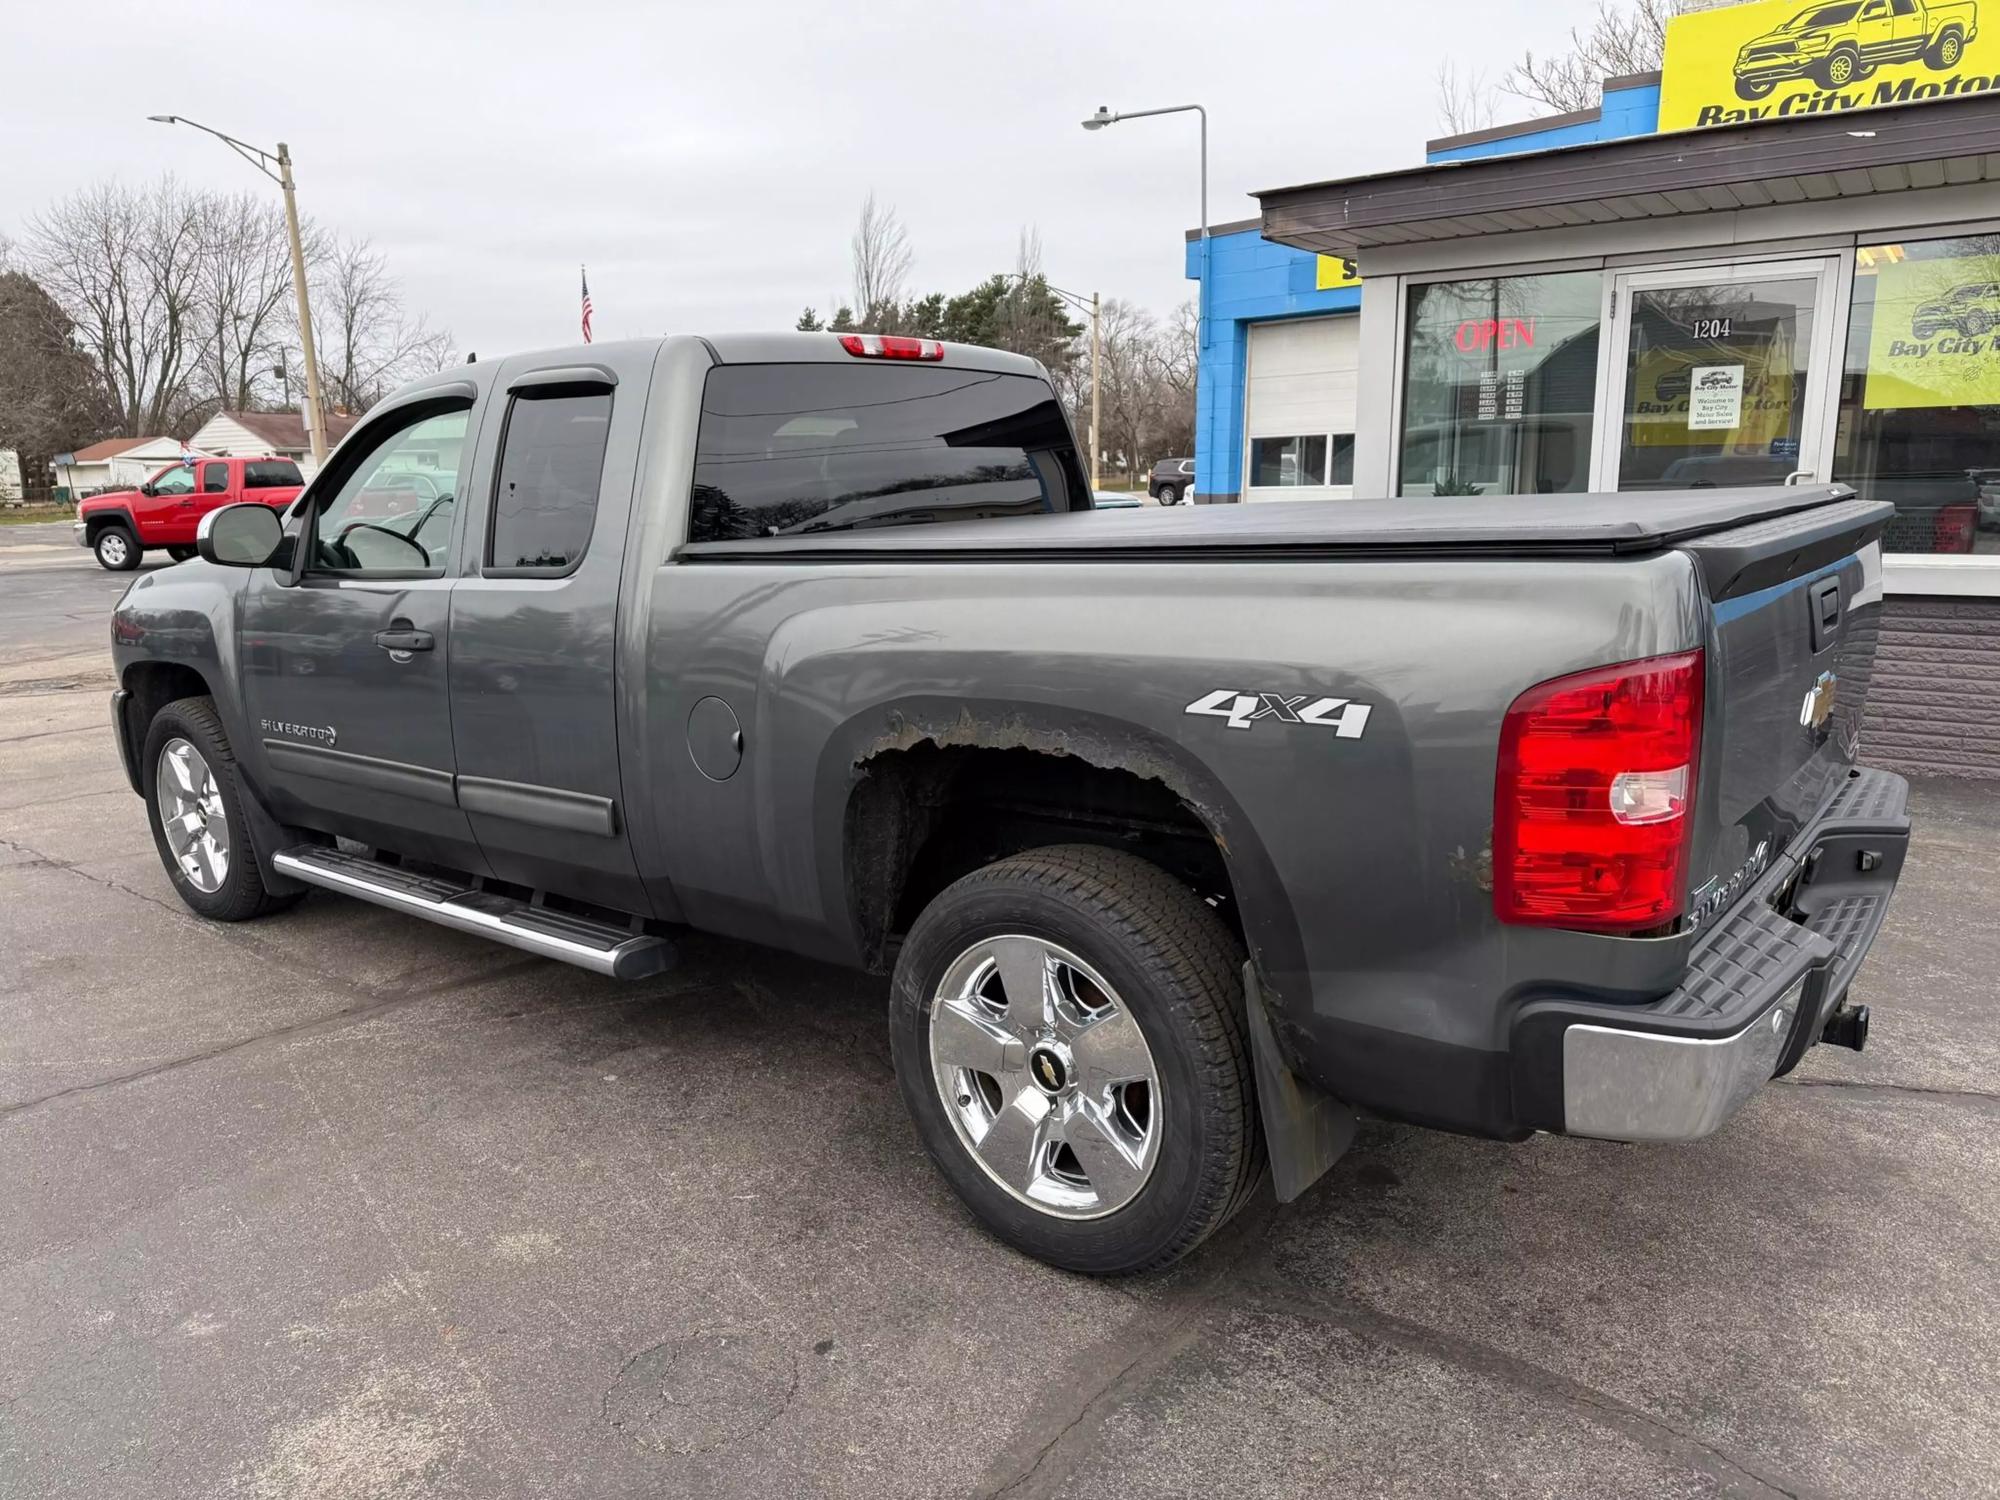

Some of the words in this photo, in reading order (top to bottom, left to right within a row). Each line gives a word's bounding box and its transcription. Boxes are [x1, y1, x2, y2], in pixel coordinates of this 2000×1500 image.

[1456, 316, 1536, 352] OPEN
[1694, 319, 1731, 339] 1204
[1888, 340, 1934, 359] Bay
[1937, 337, 1986, 356] City
[261, 719, 326, 740] SILVERADO
